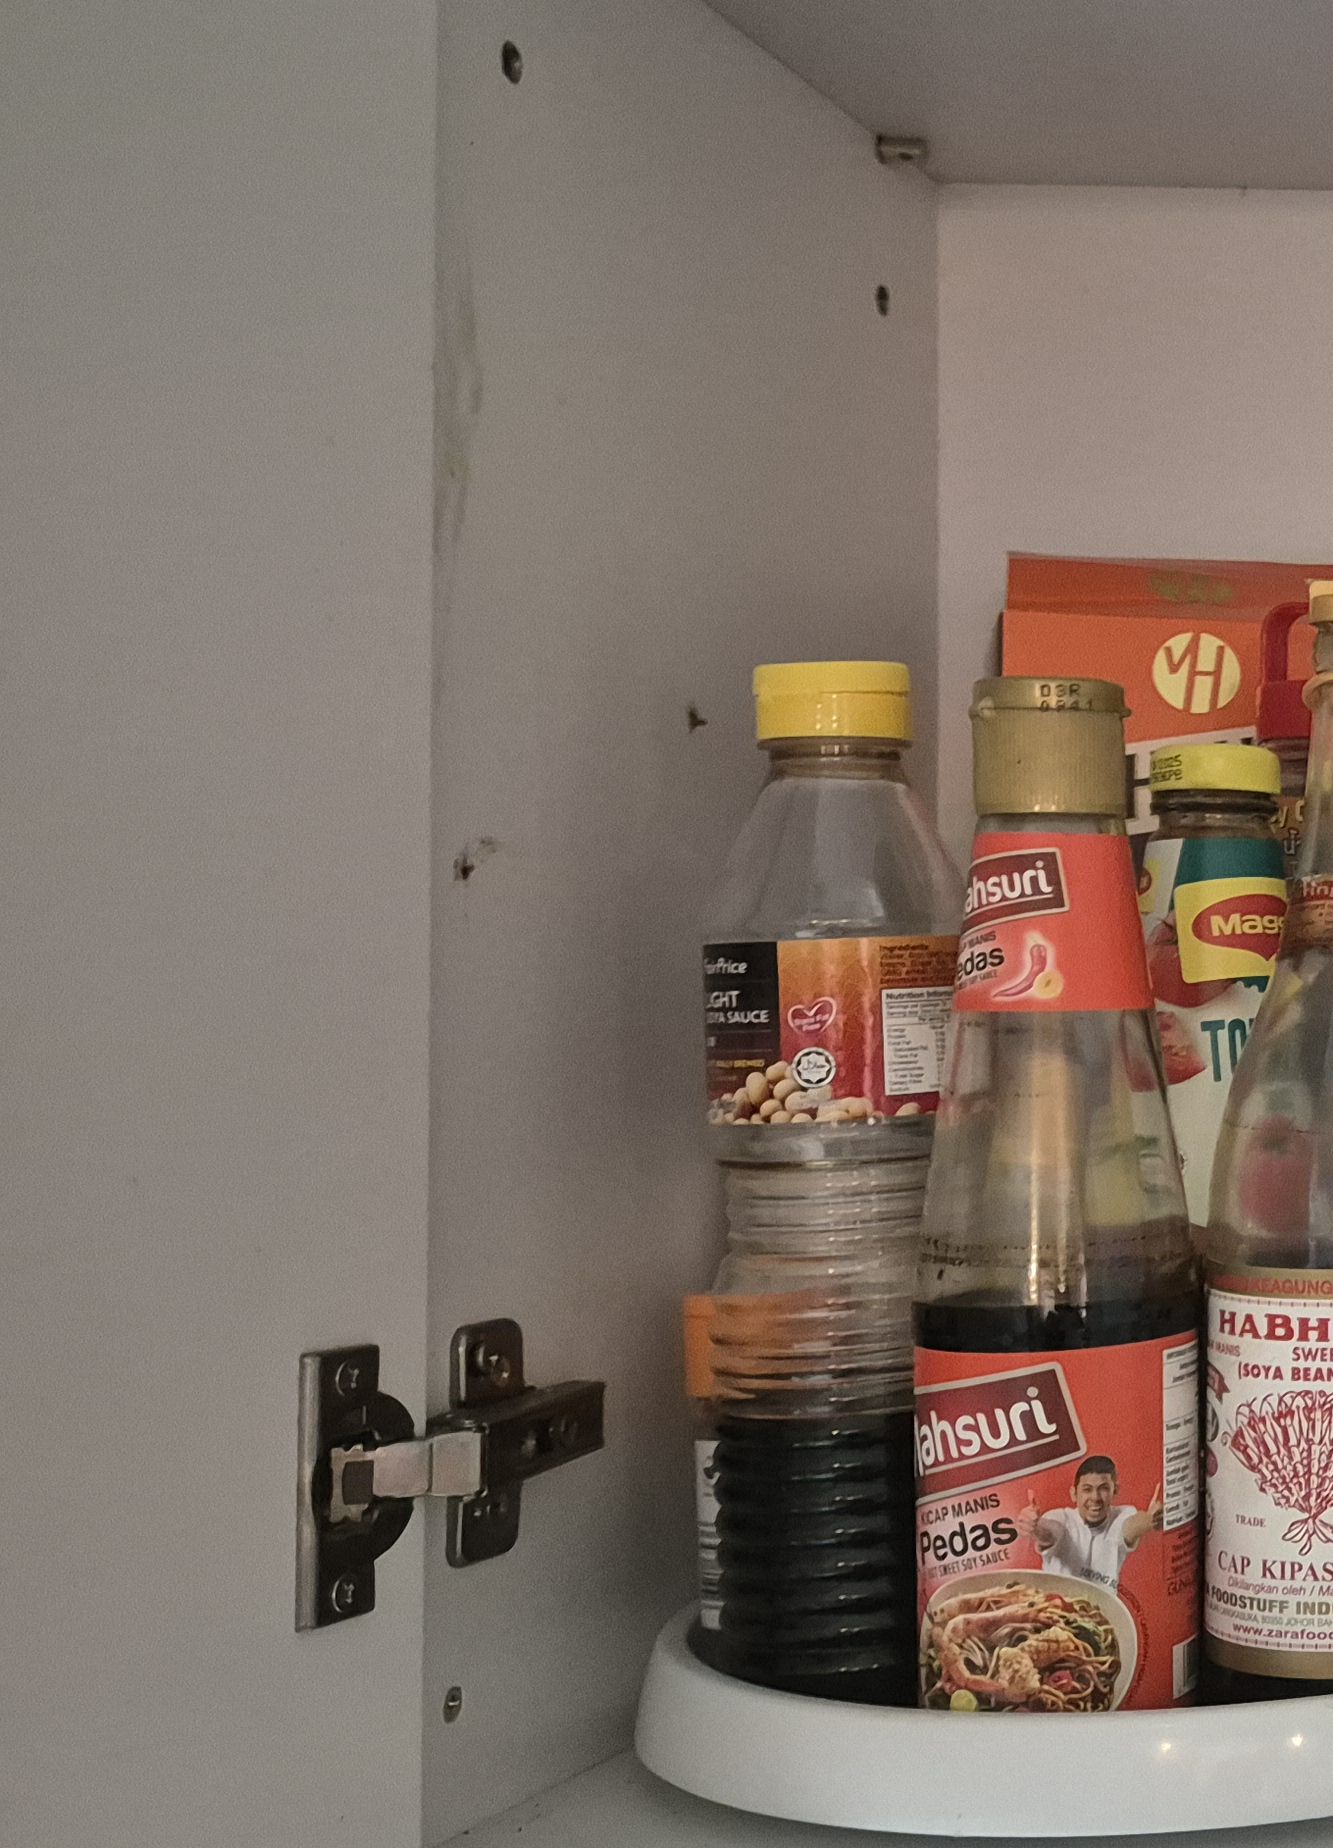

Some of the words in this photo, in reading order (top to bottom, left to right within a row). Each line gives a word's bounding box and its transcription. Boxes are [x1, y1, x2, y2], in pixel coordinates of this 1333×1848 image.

[964, 859, 1054, 914] ahsuri
[957, 944, 1006, 982] edas
[727, 1009, 770, 1025] SAUCE
[1238, 1362, 1284, 1381] (SOYA
[915, 1386, 1057, 1479] ahsuri
[951, 1493, 1001, 1520] MANIS
[1234, 1514, 1266, 1528] TRADE
[920, 1516, 1019, 1566] Pedas
[962, 1557, 979, 1572] SOY
[979, 1548, 1011, 1566] SAUCE
[1218, 1551, 1251, 1576] CAP
[1210, 1588, 1290, 1615] FOODSTUFF
[1276, 1583, 1306, 1597] oleh
